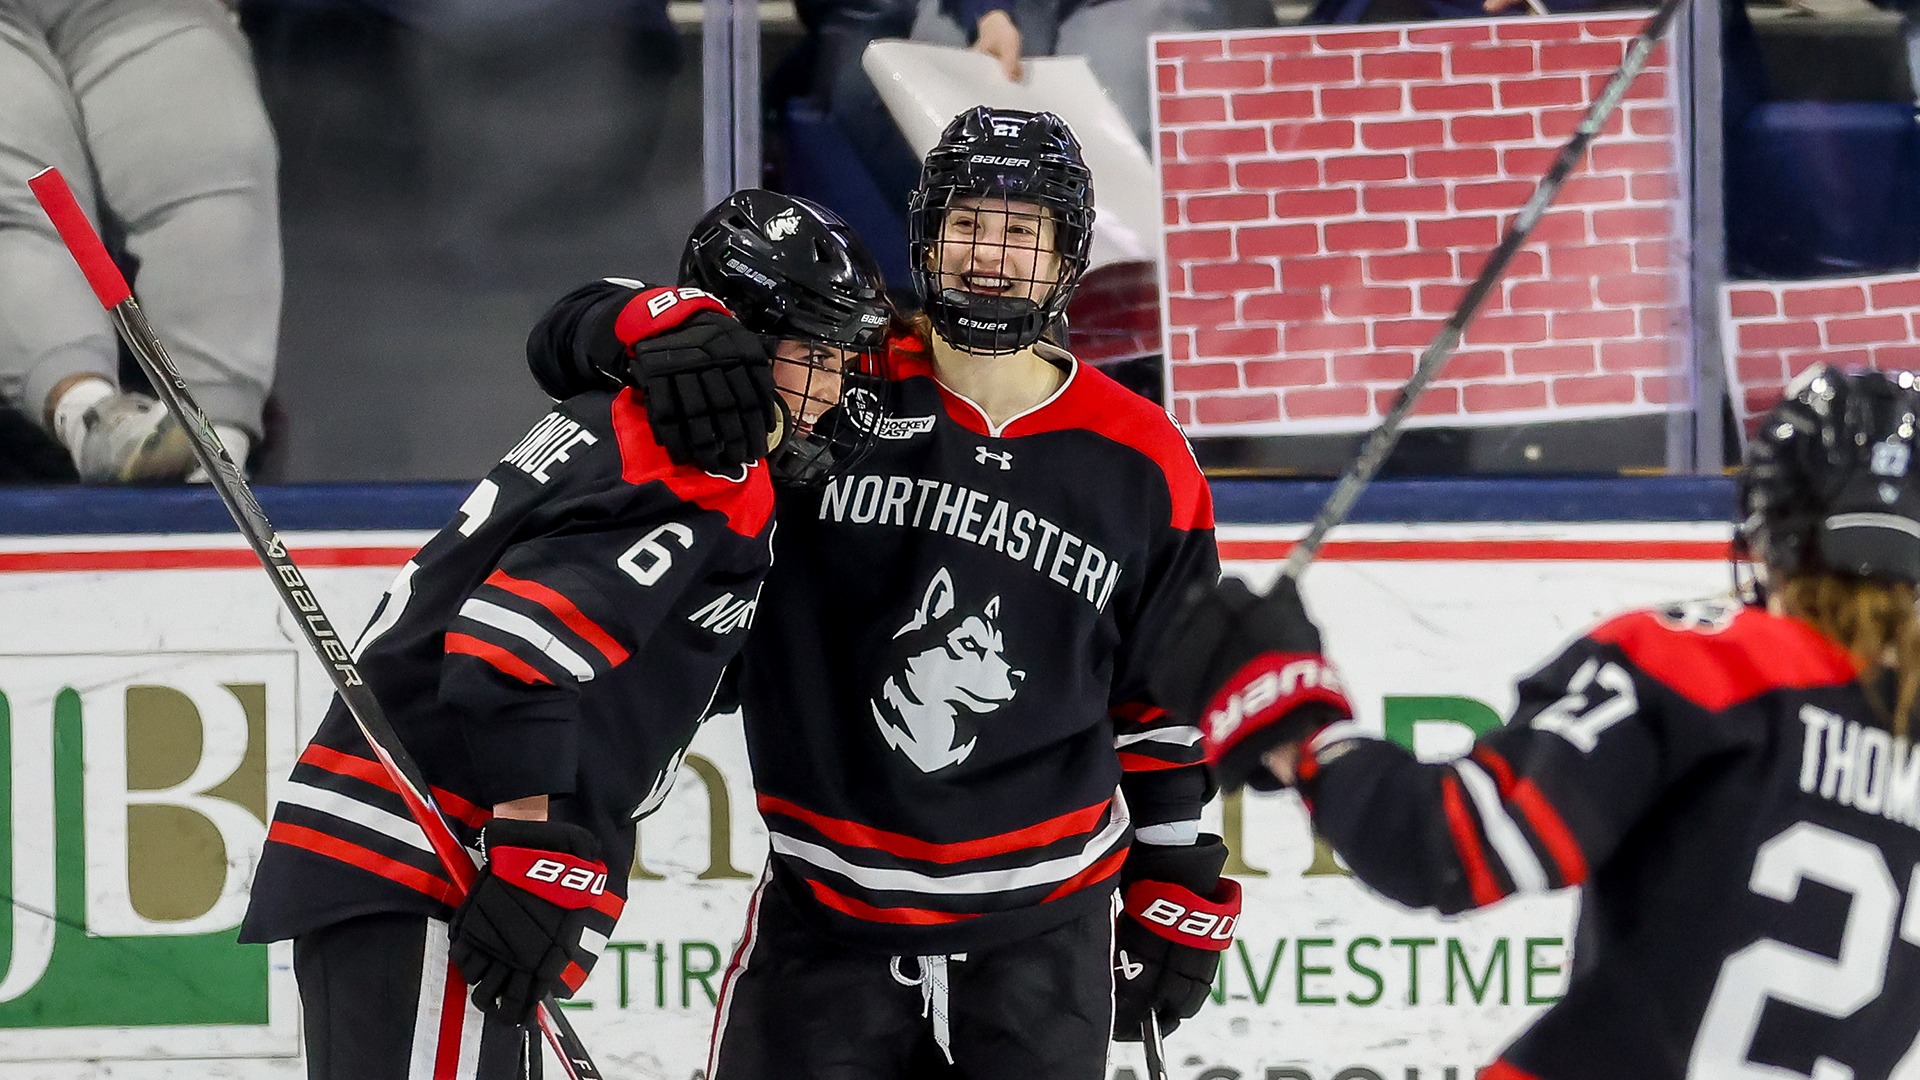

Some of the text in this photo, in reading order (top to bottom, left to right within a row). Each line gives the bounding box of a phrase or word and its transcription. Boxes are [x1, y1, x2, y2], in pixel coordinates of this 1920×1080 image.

[993, 124, 1021, 138] 21
[970, 154, 1031, 168] BAUER
[726, 258, 778, 290] BAUER
[957, 316, 1008, 331] BAUER
[617, 523, 694, 587] 6
[818, 474, 1123, 615] NORTHEASTERN
[276, 564, 363, 688] BAUER
